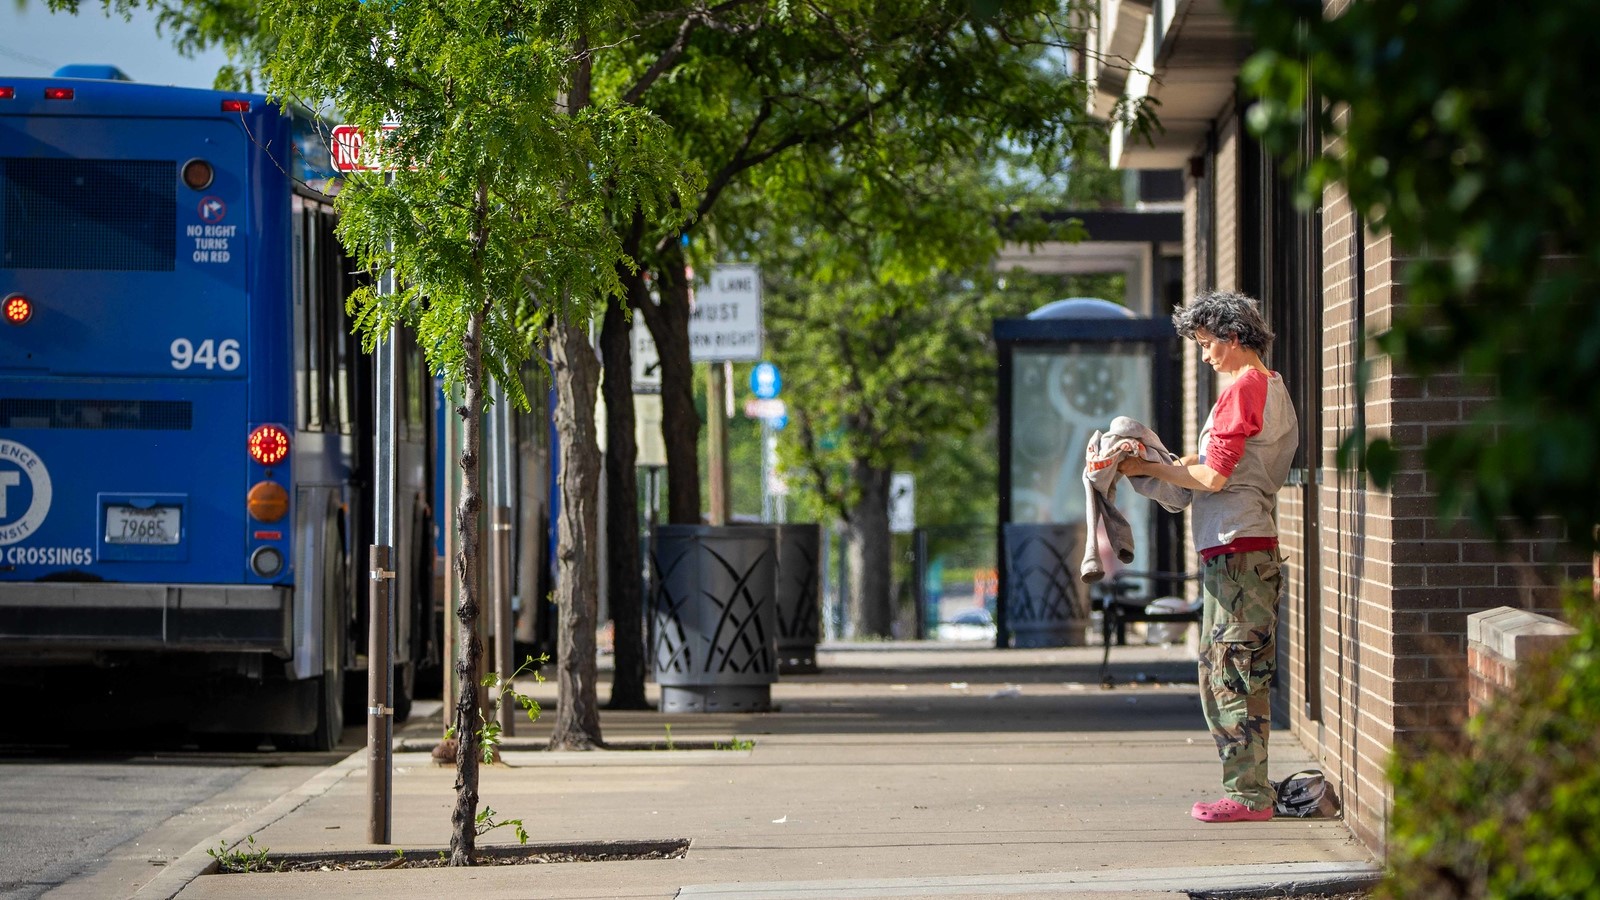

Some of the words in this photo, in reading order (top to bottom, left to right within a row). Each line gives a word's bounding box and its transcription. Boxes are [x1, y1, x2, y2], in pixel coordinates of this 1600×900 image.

[338, 133, 363, 164] NO
[186, 225, 203, 237] NO
[204, 225, 236, 238] RIGHT
[194, 238, 229, 250] TURNS
[193, 250, 209, 262] ON
[210, 250, 231, 263] RED
[170, 337, 241, 372] 946
[120, 519, 166, 538] 79685
[6, 546, 93, 566] CROSSINGS
